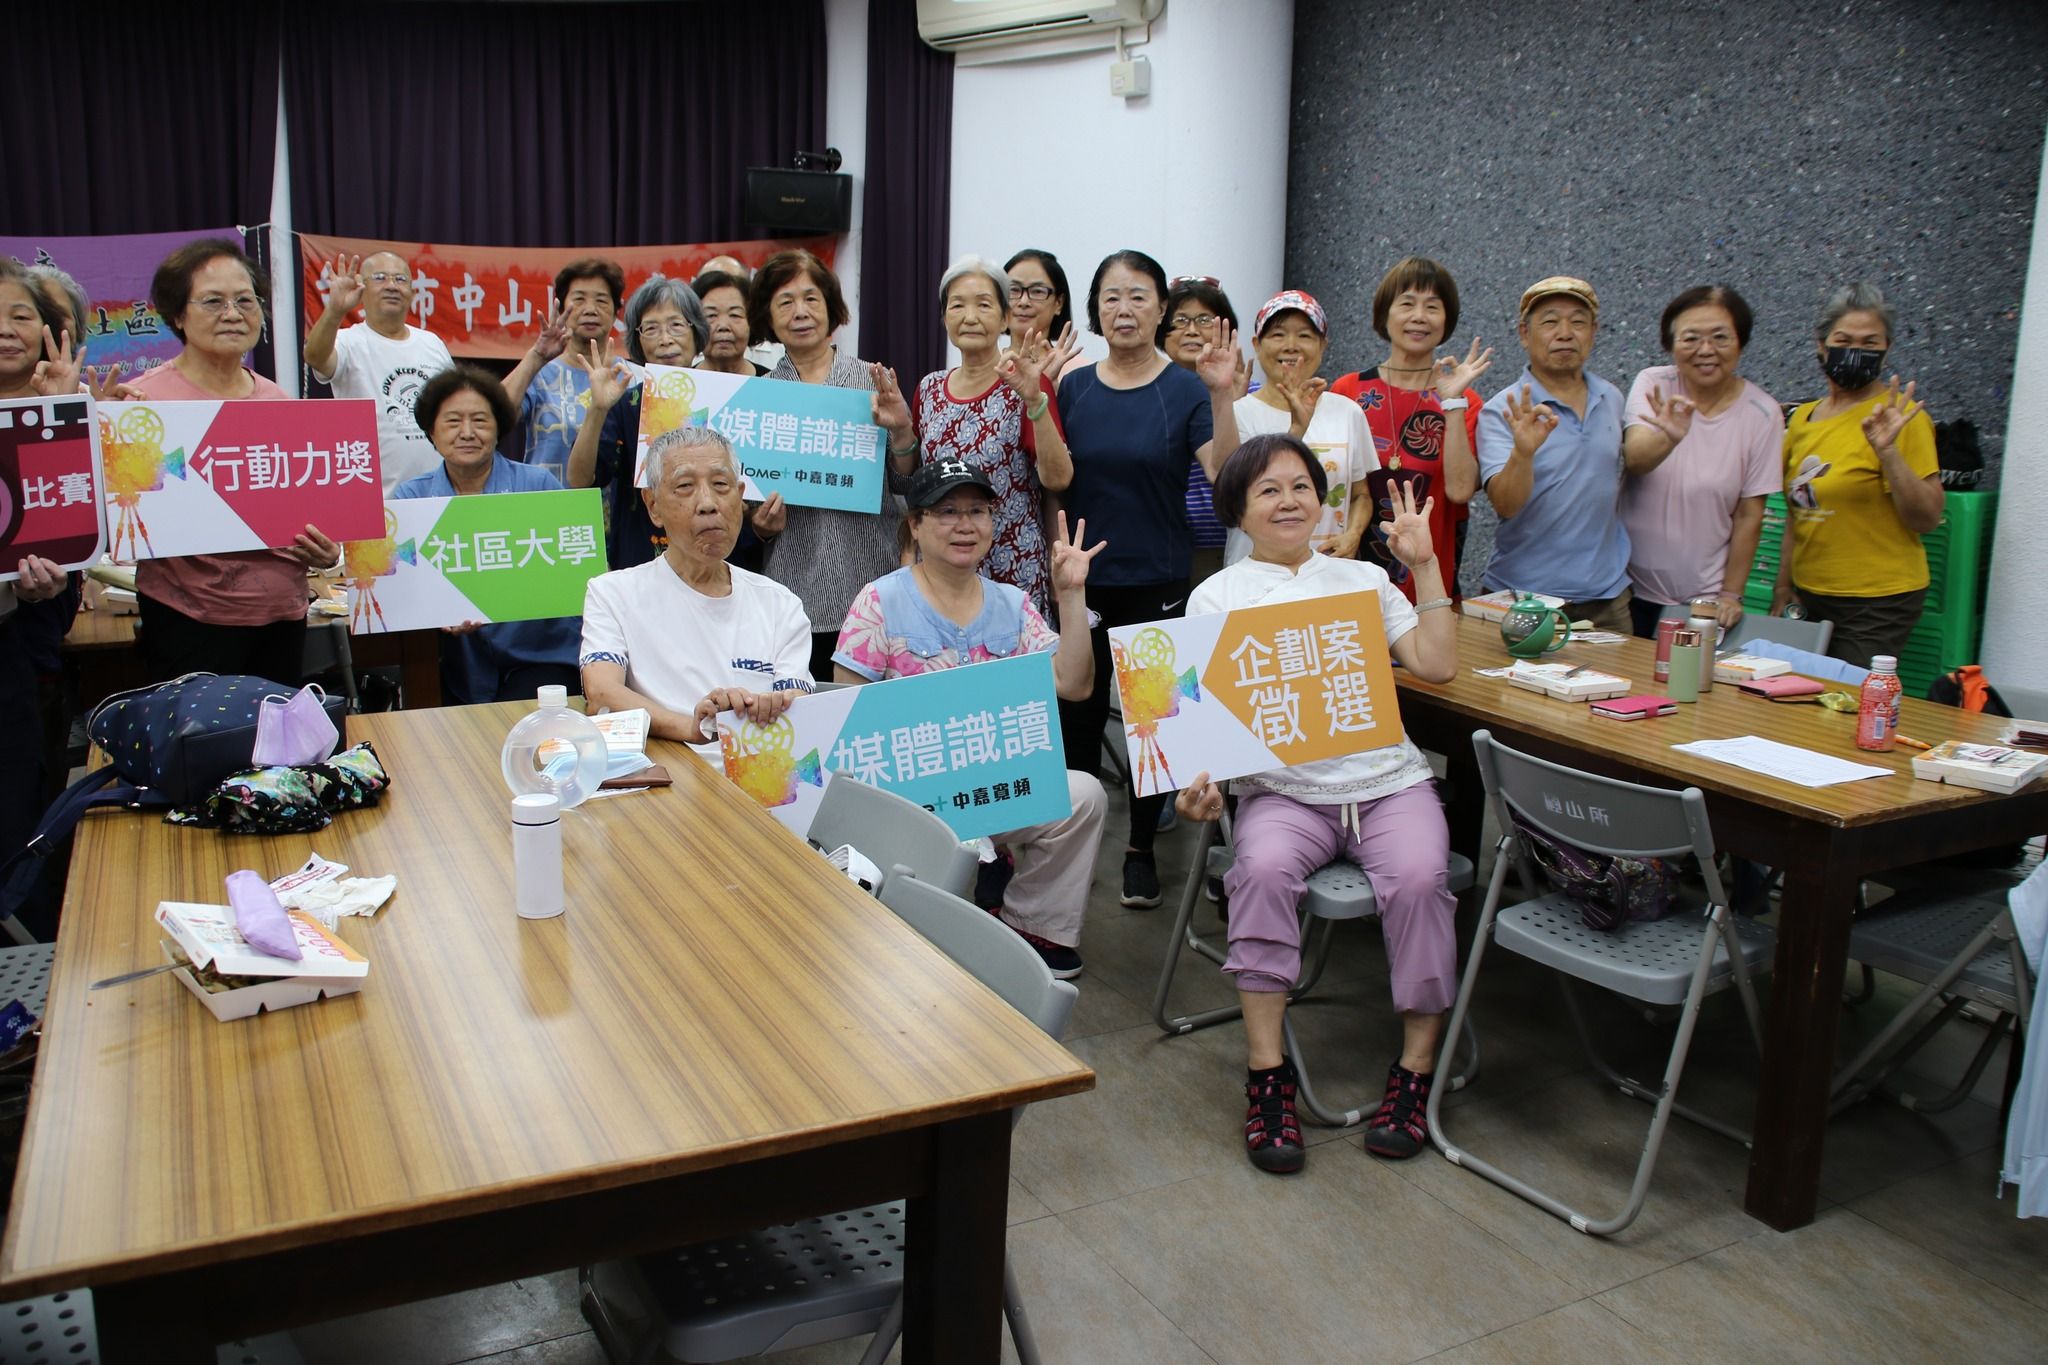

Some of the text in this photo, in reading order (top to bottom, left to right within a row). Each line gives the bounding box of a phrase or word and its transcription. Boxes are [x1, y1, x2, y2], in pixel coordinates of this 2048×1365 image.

[395, 367, 417, 376] KEEP
[718, 406, 880, 463] 媒體識讀
[199, 440, 374, 492] 行動力獎
[795, 469, 854, 488] 中嘉寬頻
[22, 472, 93, 510] 比賽
[427, 524, 597, 573] 社區大學
[1229, 620, 1366, 688] 企劃案
[833, 700, 1053, 788] 媒體識讀
[952, 777, 1032, 810] 中嘉寬頻
